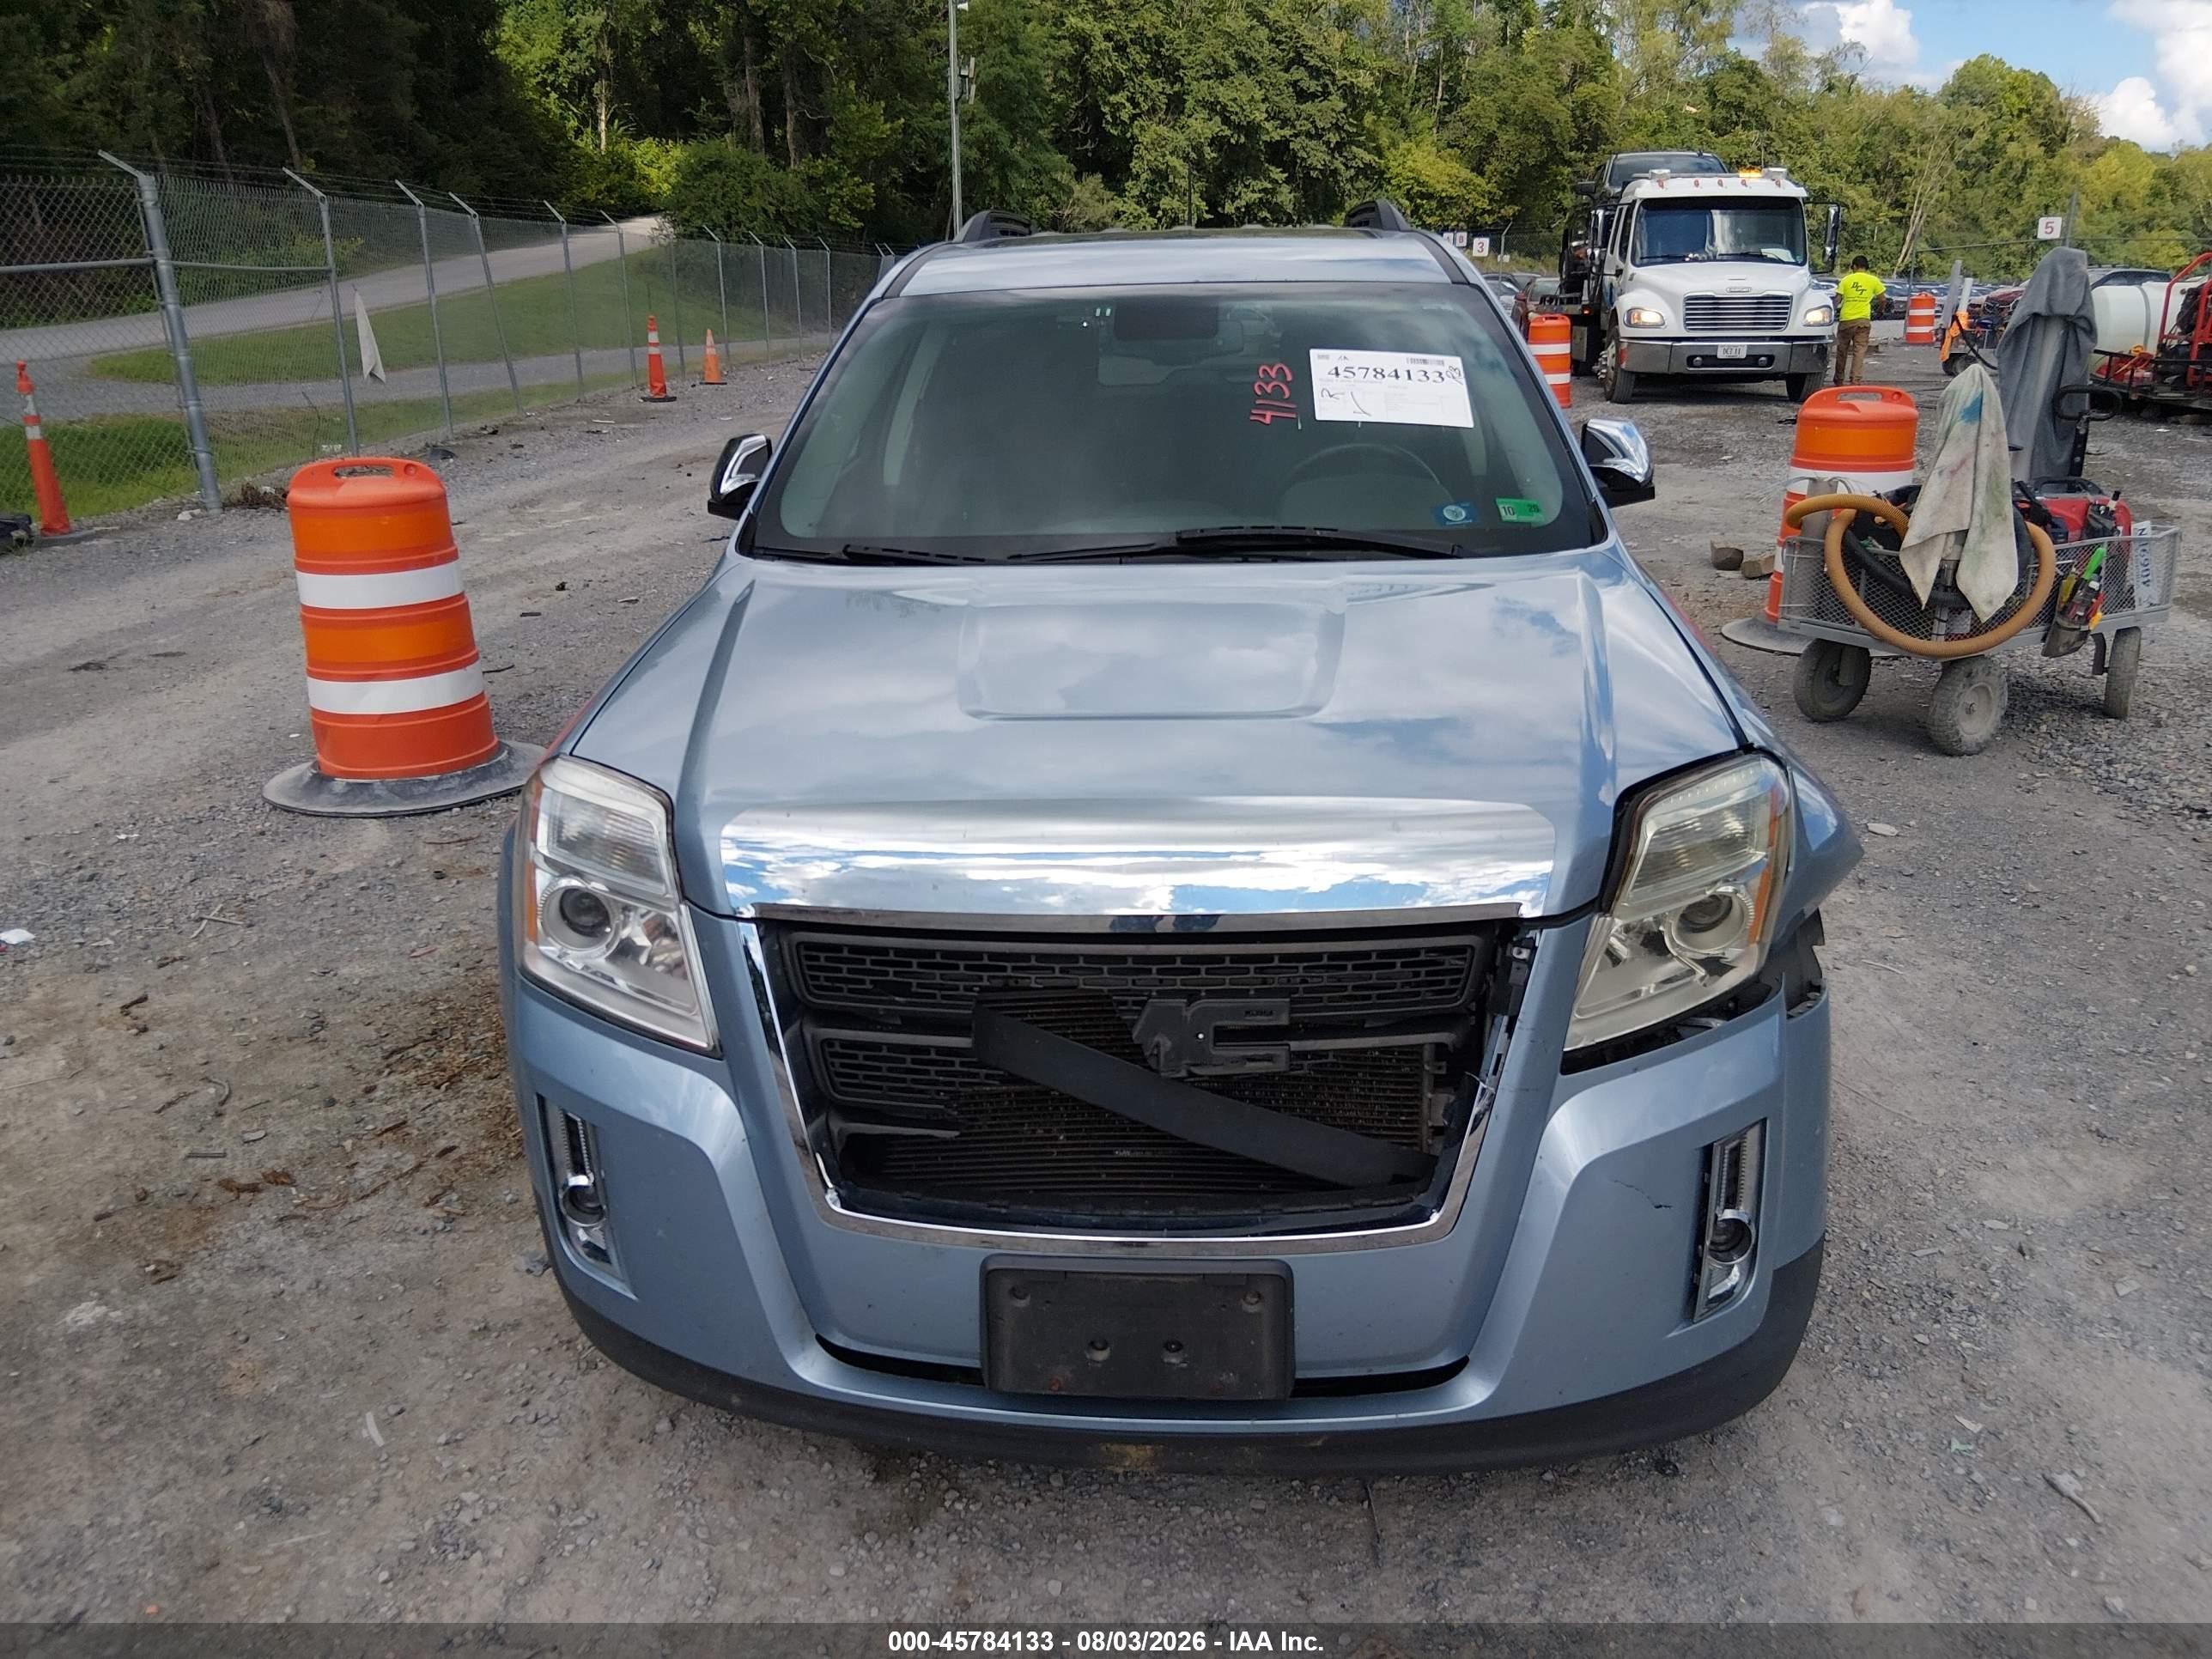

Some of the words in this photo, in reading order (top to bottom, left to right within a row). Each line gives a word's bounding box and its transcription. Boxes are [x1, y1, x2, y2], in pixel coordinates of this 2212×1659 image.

[2045, 222, 2054, 234] 5
[1477, 241, 1485, 253] 3
[1328, 366, 1445, 384] 45784133
[1250, 363, 1297, 425] 4133
[1502, 506, 1516, 516] 10
